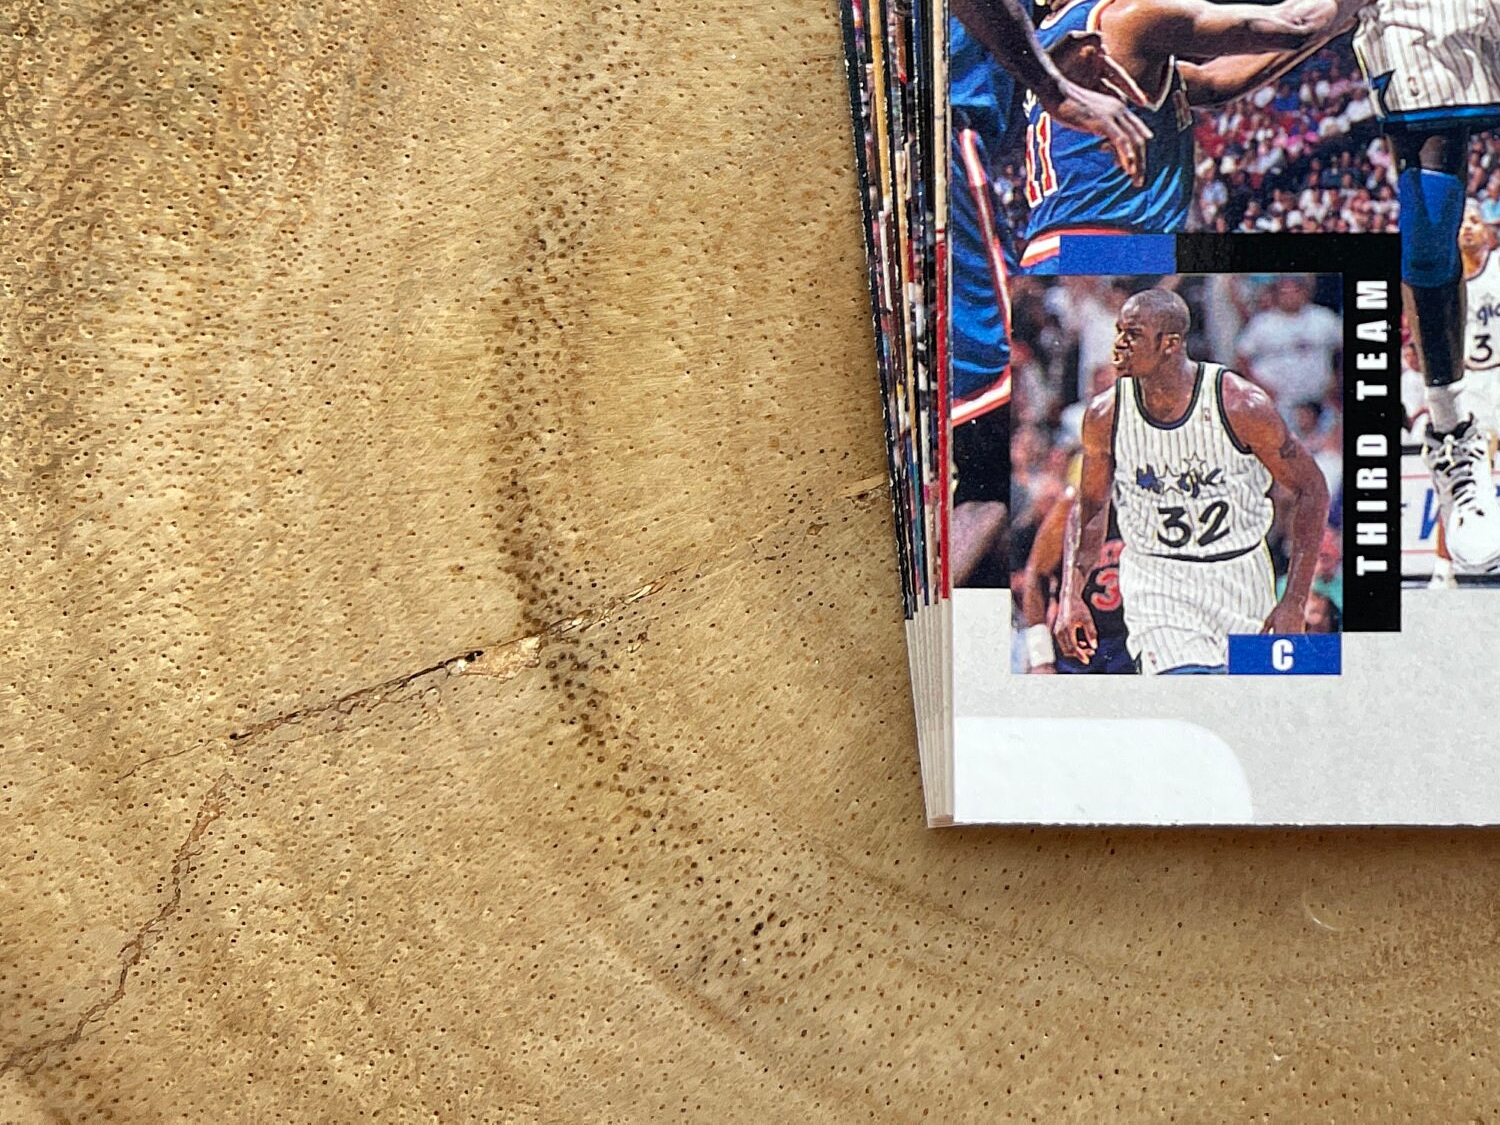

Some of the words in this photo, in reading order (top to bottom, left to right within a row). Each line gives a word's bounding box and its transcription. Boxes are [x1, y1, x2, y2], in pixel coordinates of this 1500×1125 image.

[1356, 280, 1389, 402] TEAM
[1157, 500, 1230, 548] 32
[1356, 433, 1389, 577] THIRD
[1272, 638, 1294, 672] C
